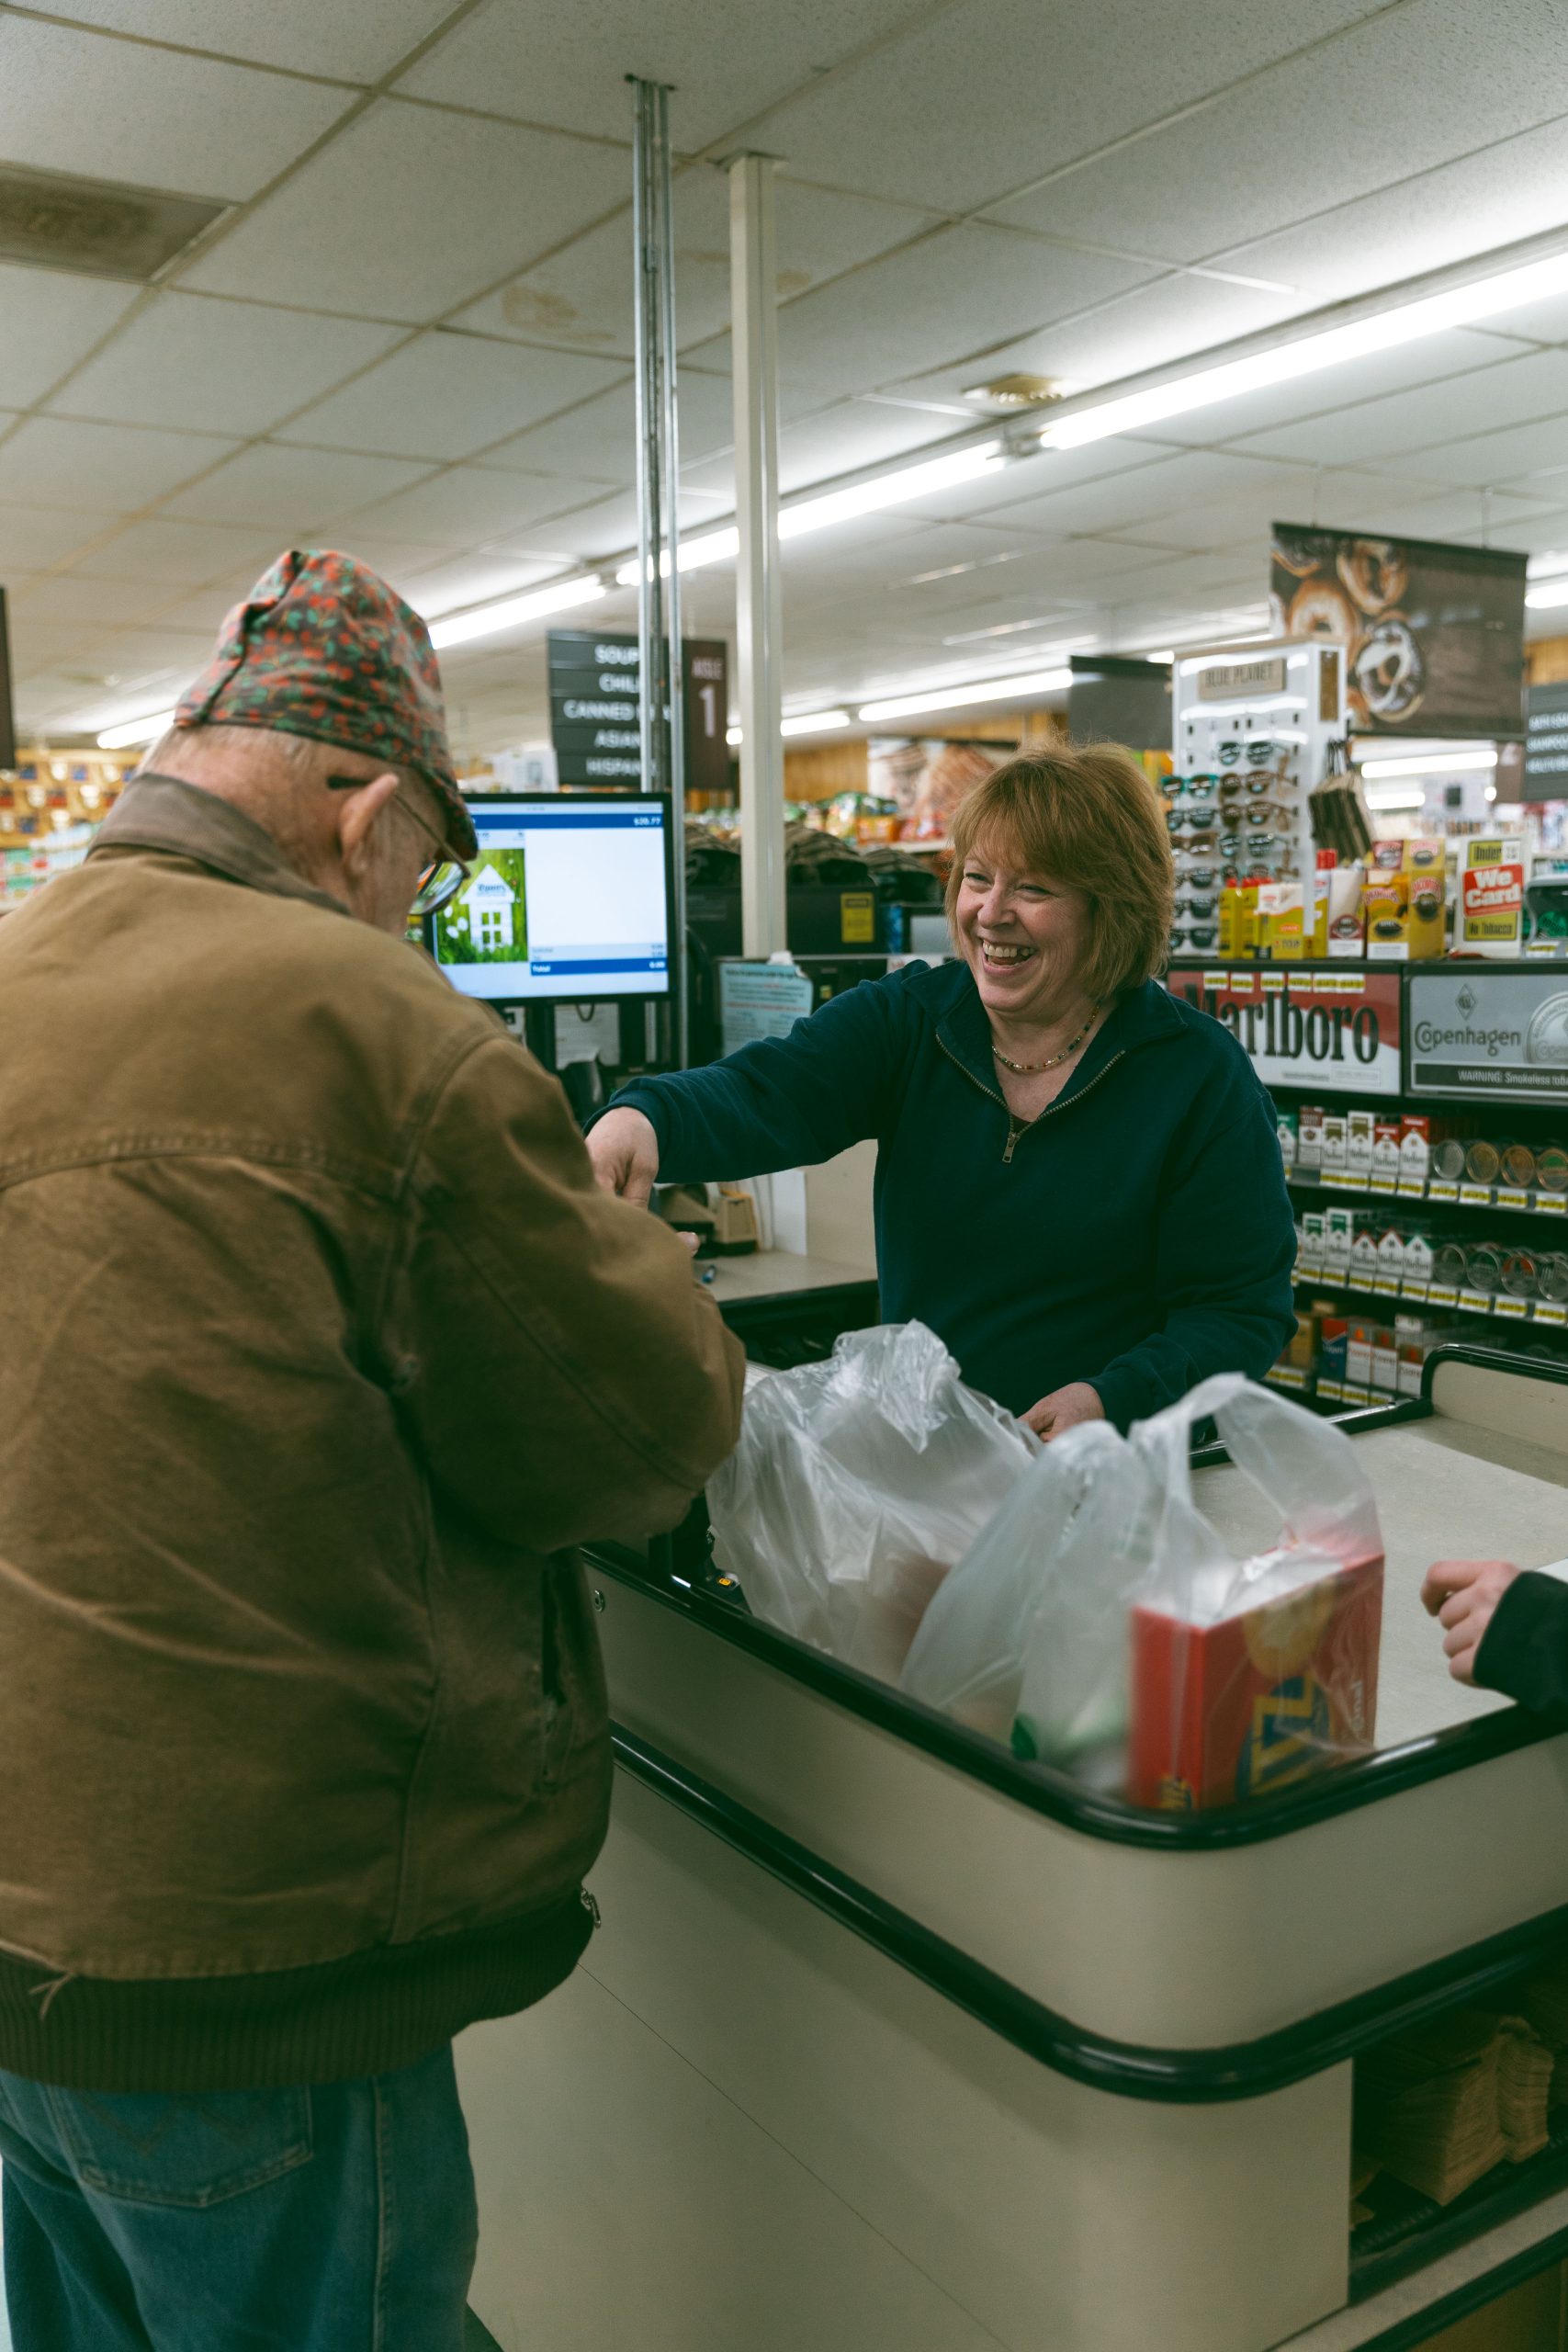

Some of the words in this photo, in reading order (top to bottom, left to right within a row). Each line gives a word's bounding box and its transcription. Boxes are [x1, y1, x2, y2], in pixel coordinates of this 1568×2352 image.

[1205, 669, 1231, 687] BLUE
[563, 699, 635, 720] CANNED
[699, 685, 716, 738] 1
[586, 758, 657, 777] HISPAN
[1473, 868, 1513, 888] We
[1466, 883, 1521, 908] Card
[1482, 922, 1513, 935] Tobacco
[1415, 1021, 1521, 1057] Copenhagen
[1458, 1069, 1503, 1082] WARNING:
